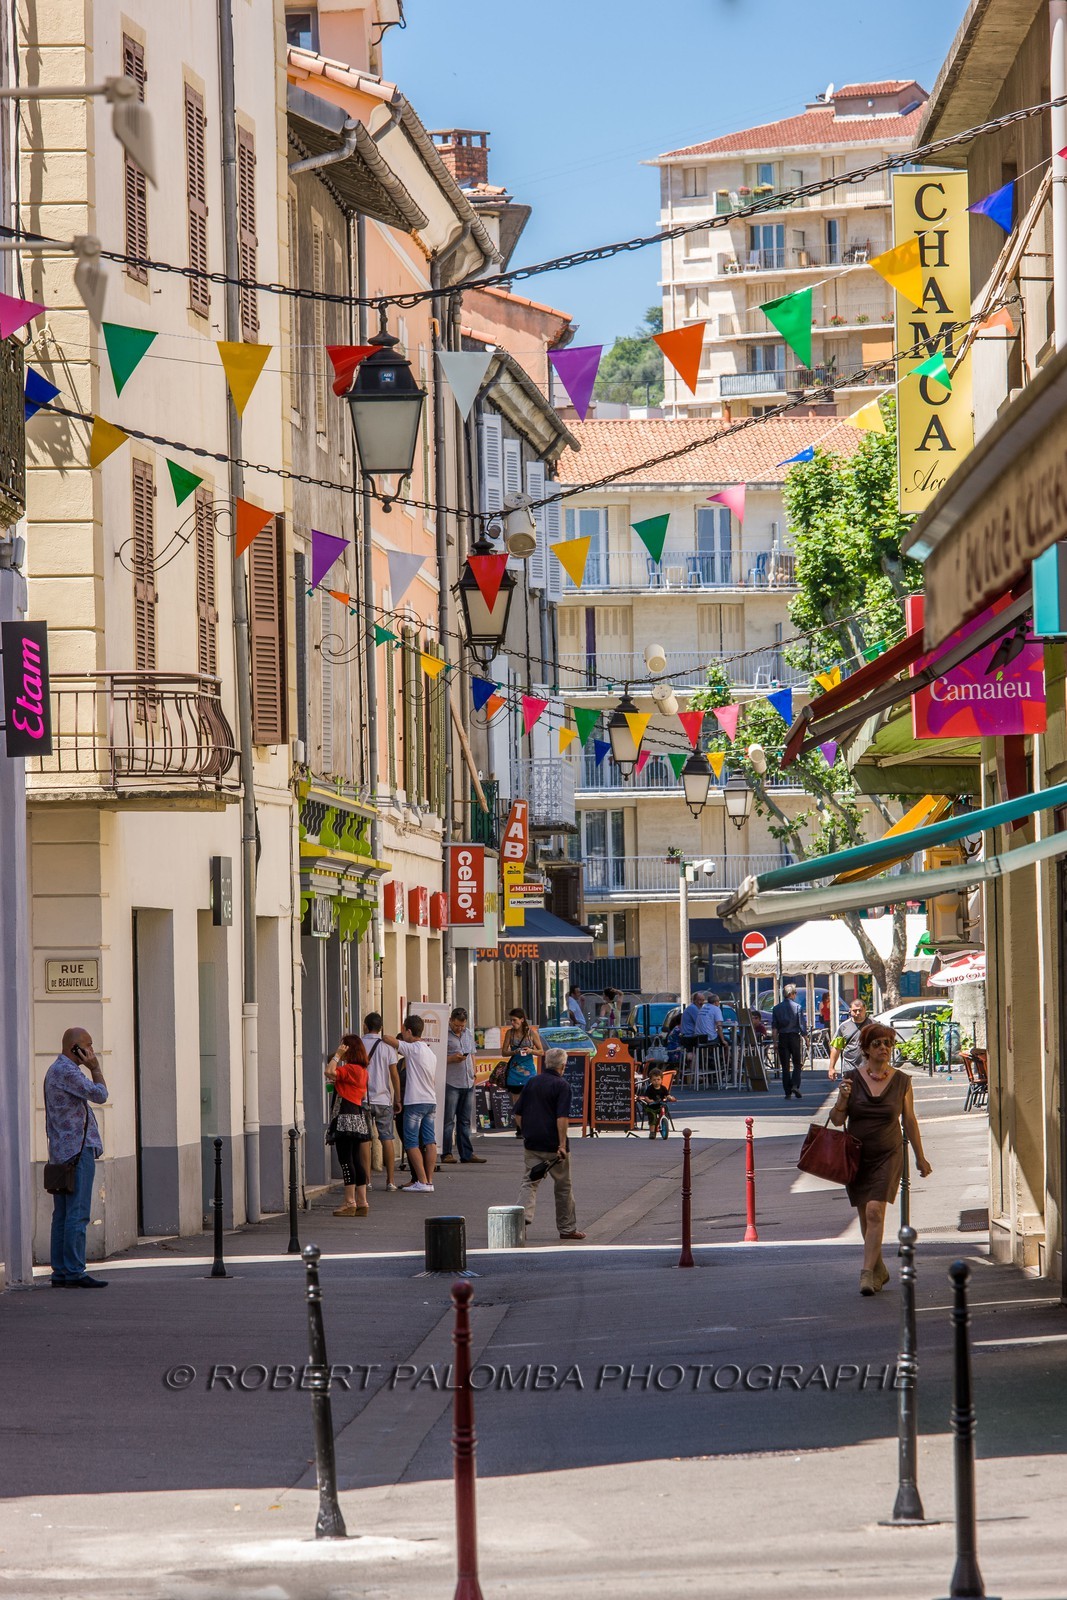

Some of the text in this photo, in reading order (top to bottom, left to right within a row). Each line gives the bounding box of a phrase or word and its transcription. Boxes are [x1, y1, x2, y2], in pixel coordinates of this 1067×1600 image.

[904, 459, 946, 493] Acc
[12, 637, 44, 739] Etam
[503, 803, 526, 858] TAB
[503, 943, 540, 959] COFFEE
[61, 964, 84, 974] RUE
[58, 977, 94, 987] BEAUTEVILLE
[946, 975, 965, 983] MIKO
